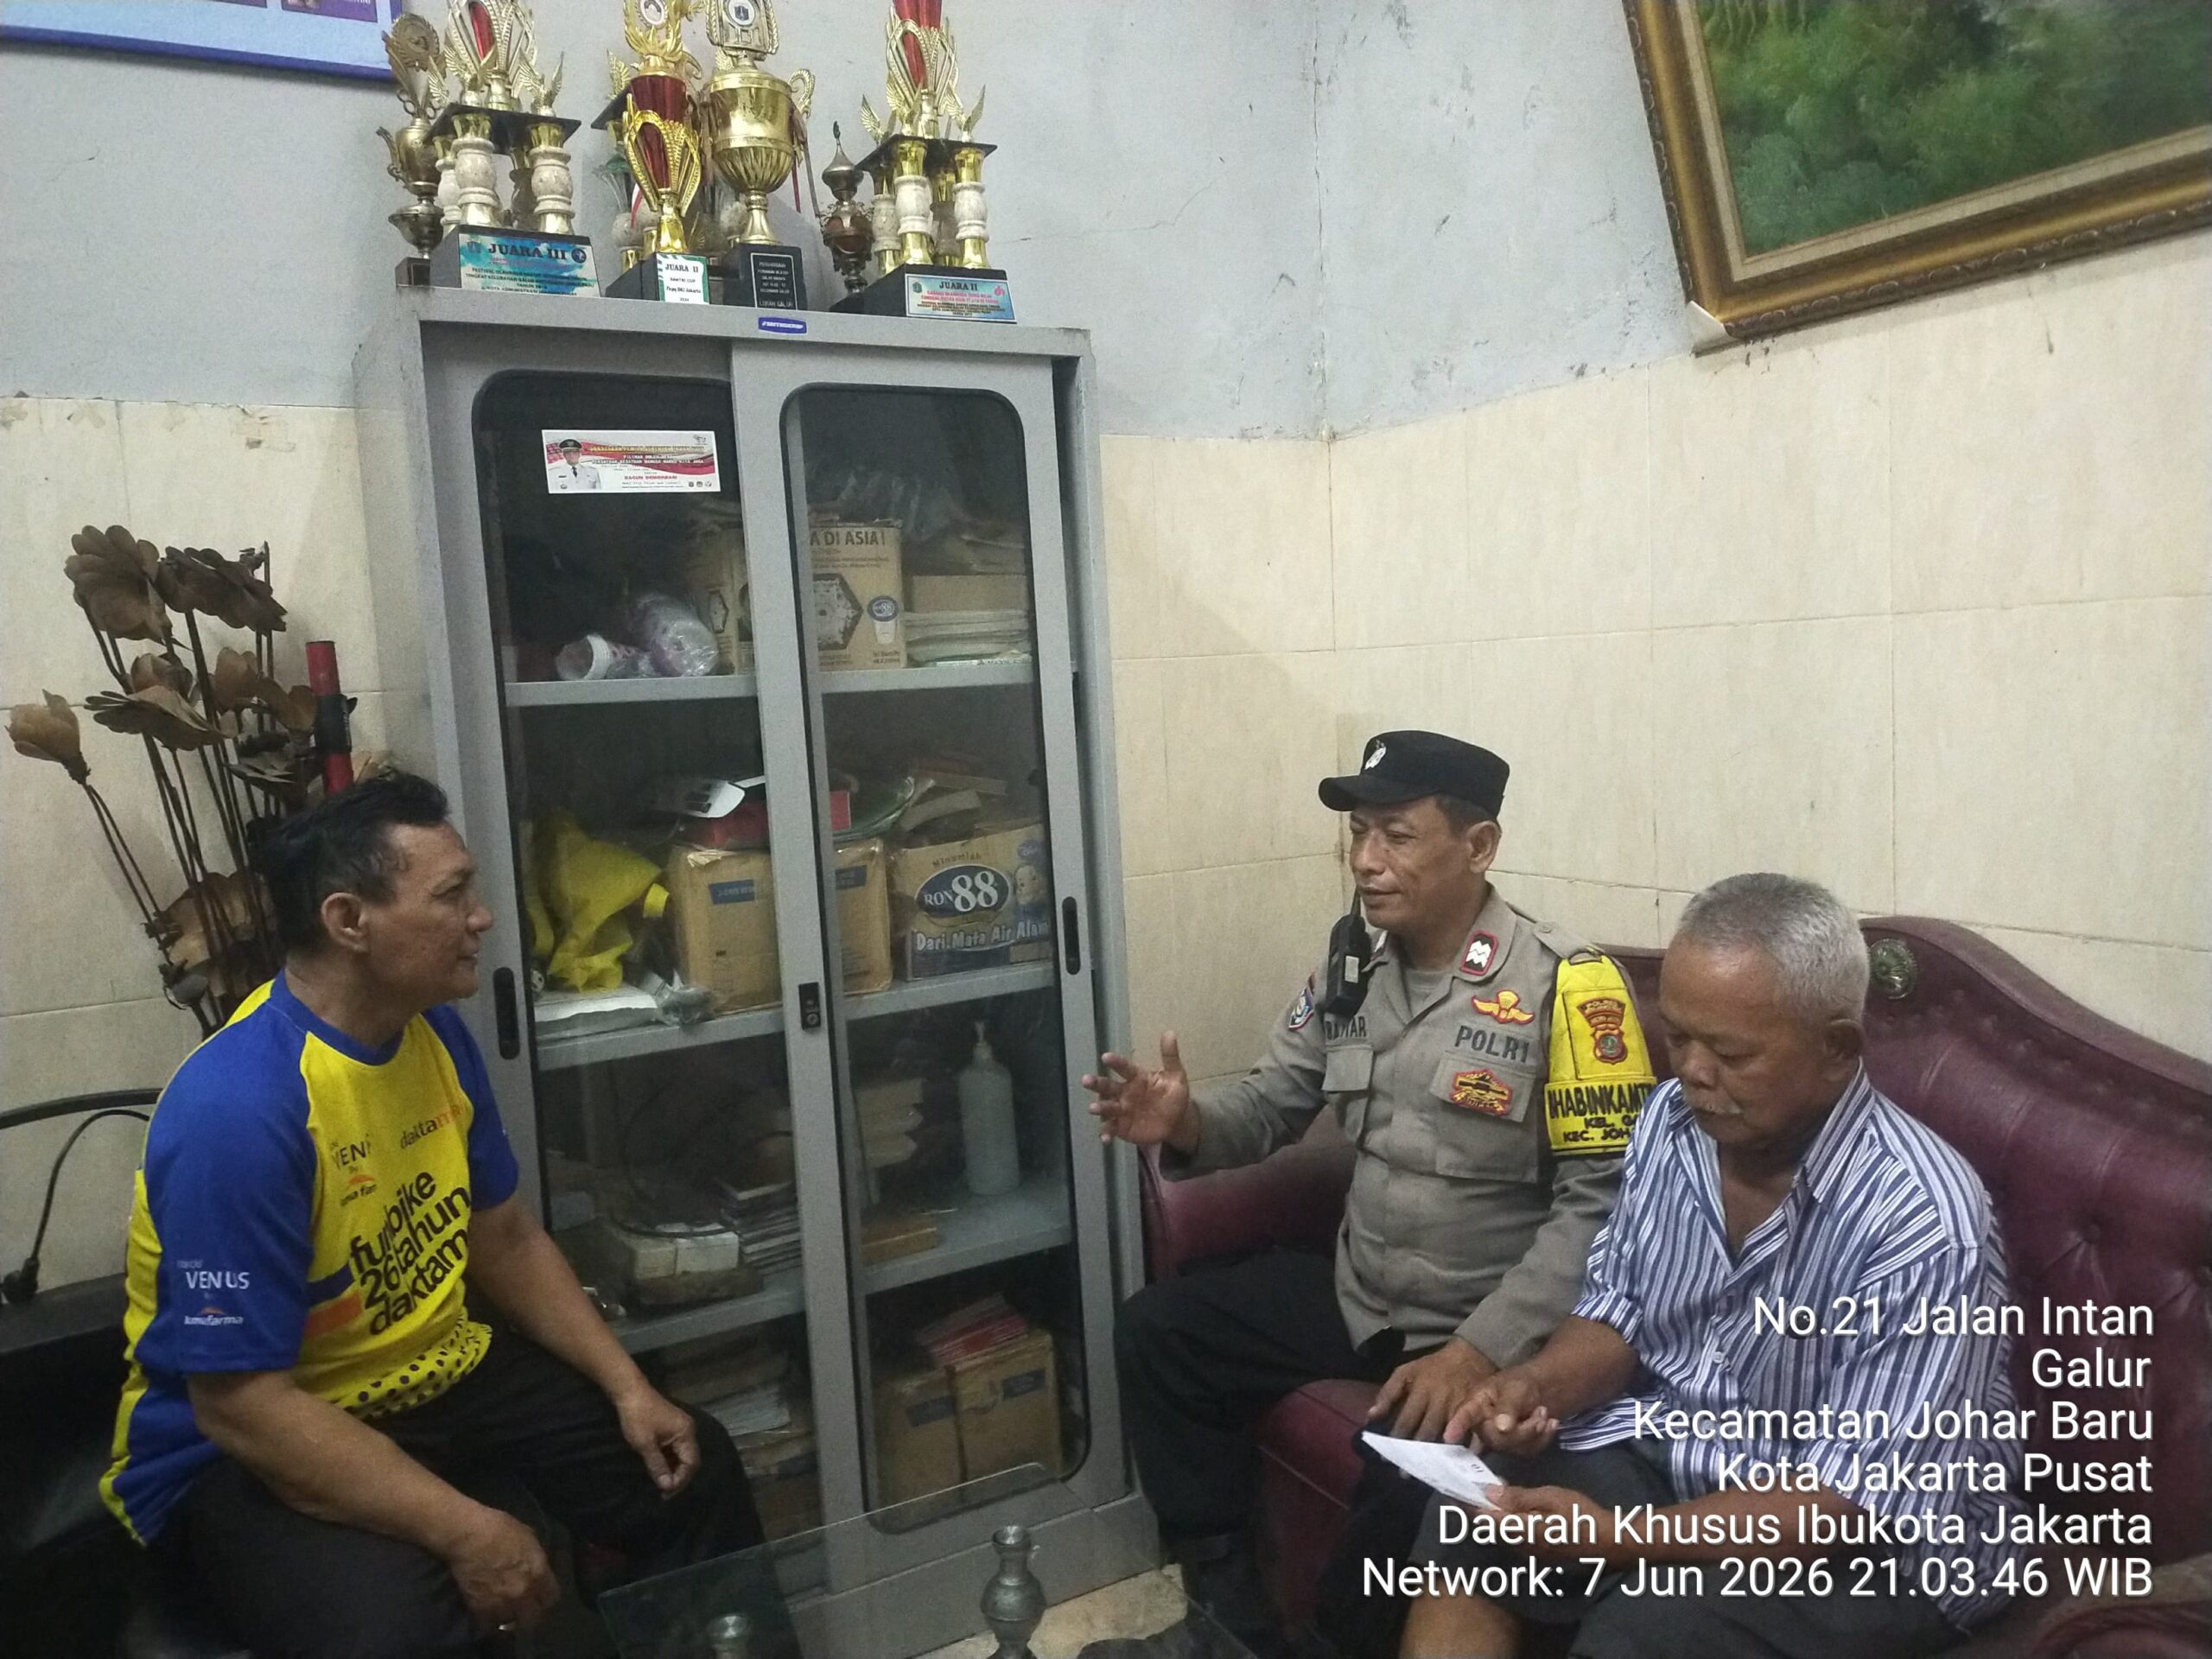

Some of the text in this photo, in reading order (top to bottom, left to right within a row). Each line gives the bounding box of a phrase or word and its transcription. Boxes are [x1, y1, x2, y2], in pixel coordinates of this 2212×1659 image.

[488, 244, 568, 260] JUARA III
[664, 263, 690, 273] JUARA
[939, 281, 969, 290] JUARA
[824, 531, 840, 546] DI
[951, 870, 999, 912] 88
[951, 930, 987, 950] Mata
[991, 924, 1012, 944] Air
[1454, 1025, 1529, 1064] POLRI
[1601, 1127, 1636, 1141] JOH
[392, 1186, 471, 1276] tahun
[186, 1270, 251, 1290] VENUS
